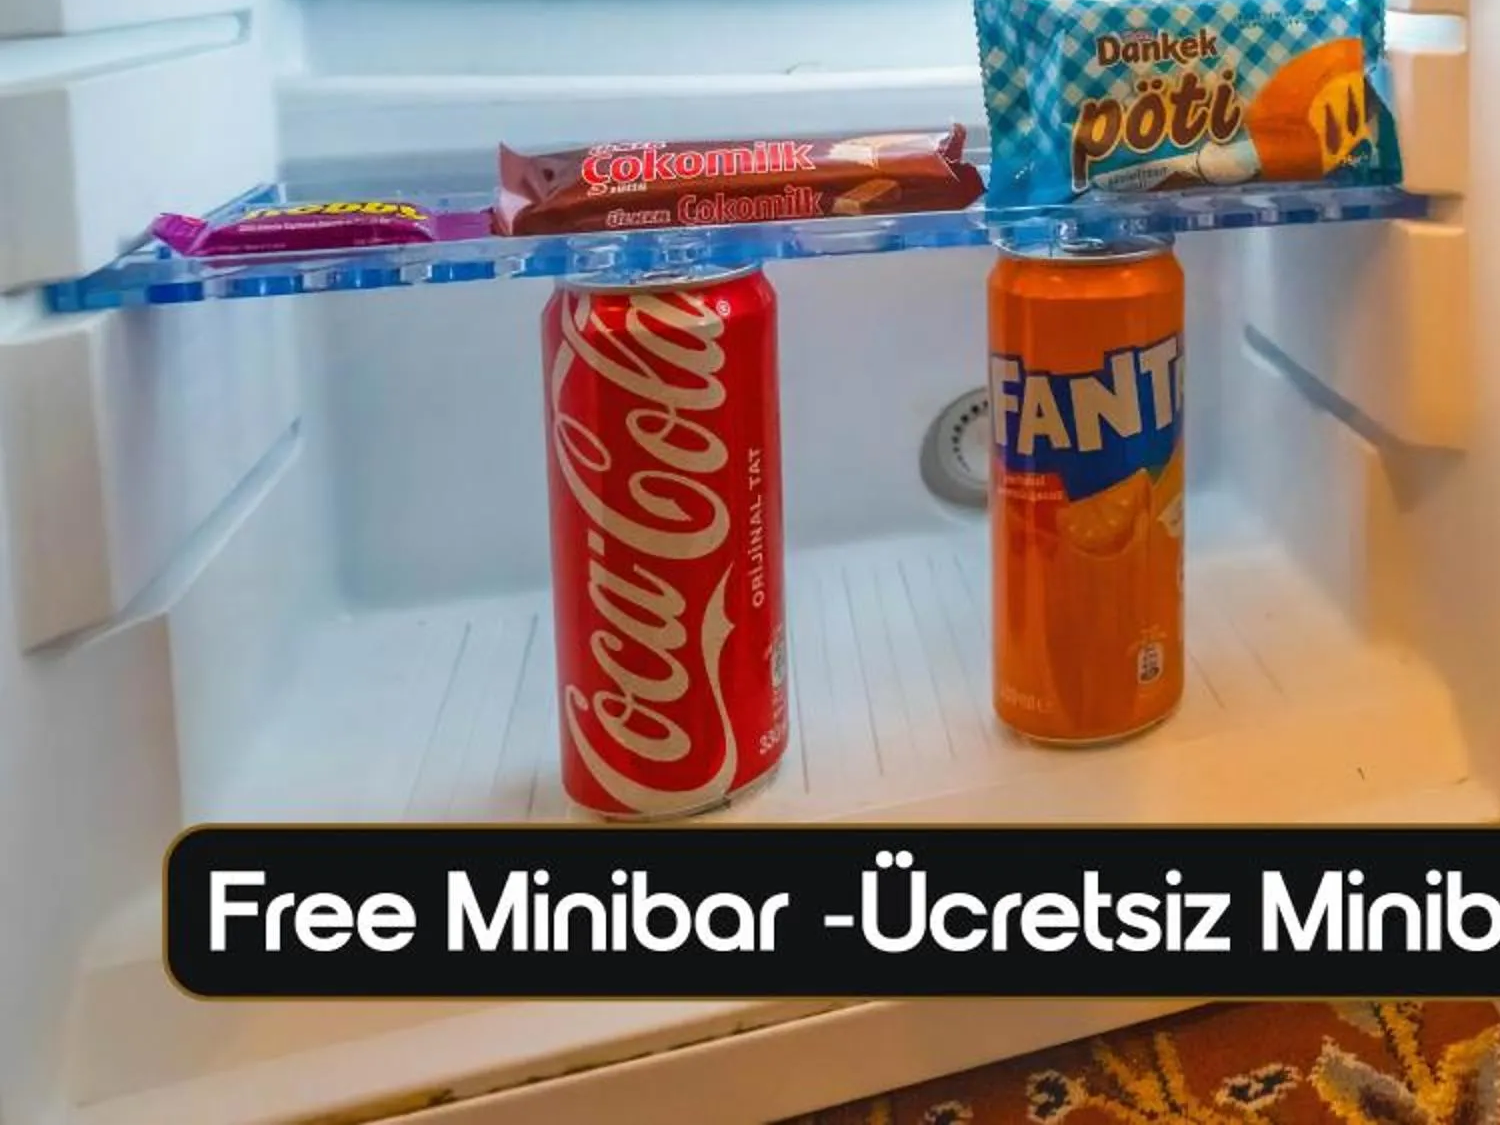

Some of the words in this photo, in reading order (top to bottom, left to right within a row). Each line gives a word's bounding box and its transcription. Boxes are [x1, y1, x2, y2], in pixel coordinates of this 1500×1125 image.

[1096, 28, 1218, 67] Dankek
[1071, 69, 1242, 194] pöti
[991, 336, 1185, 458] FANT
[748, 448, 762, 491] TAT
